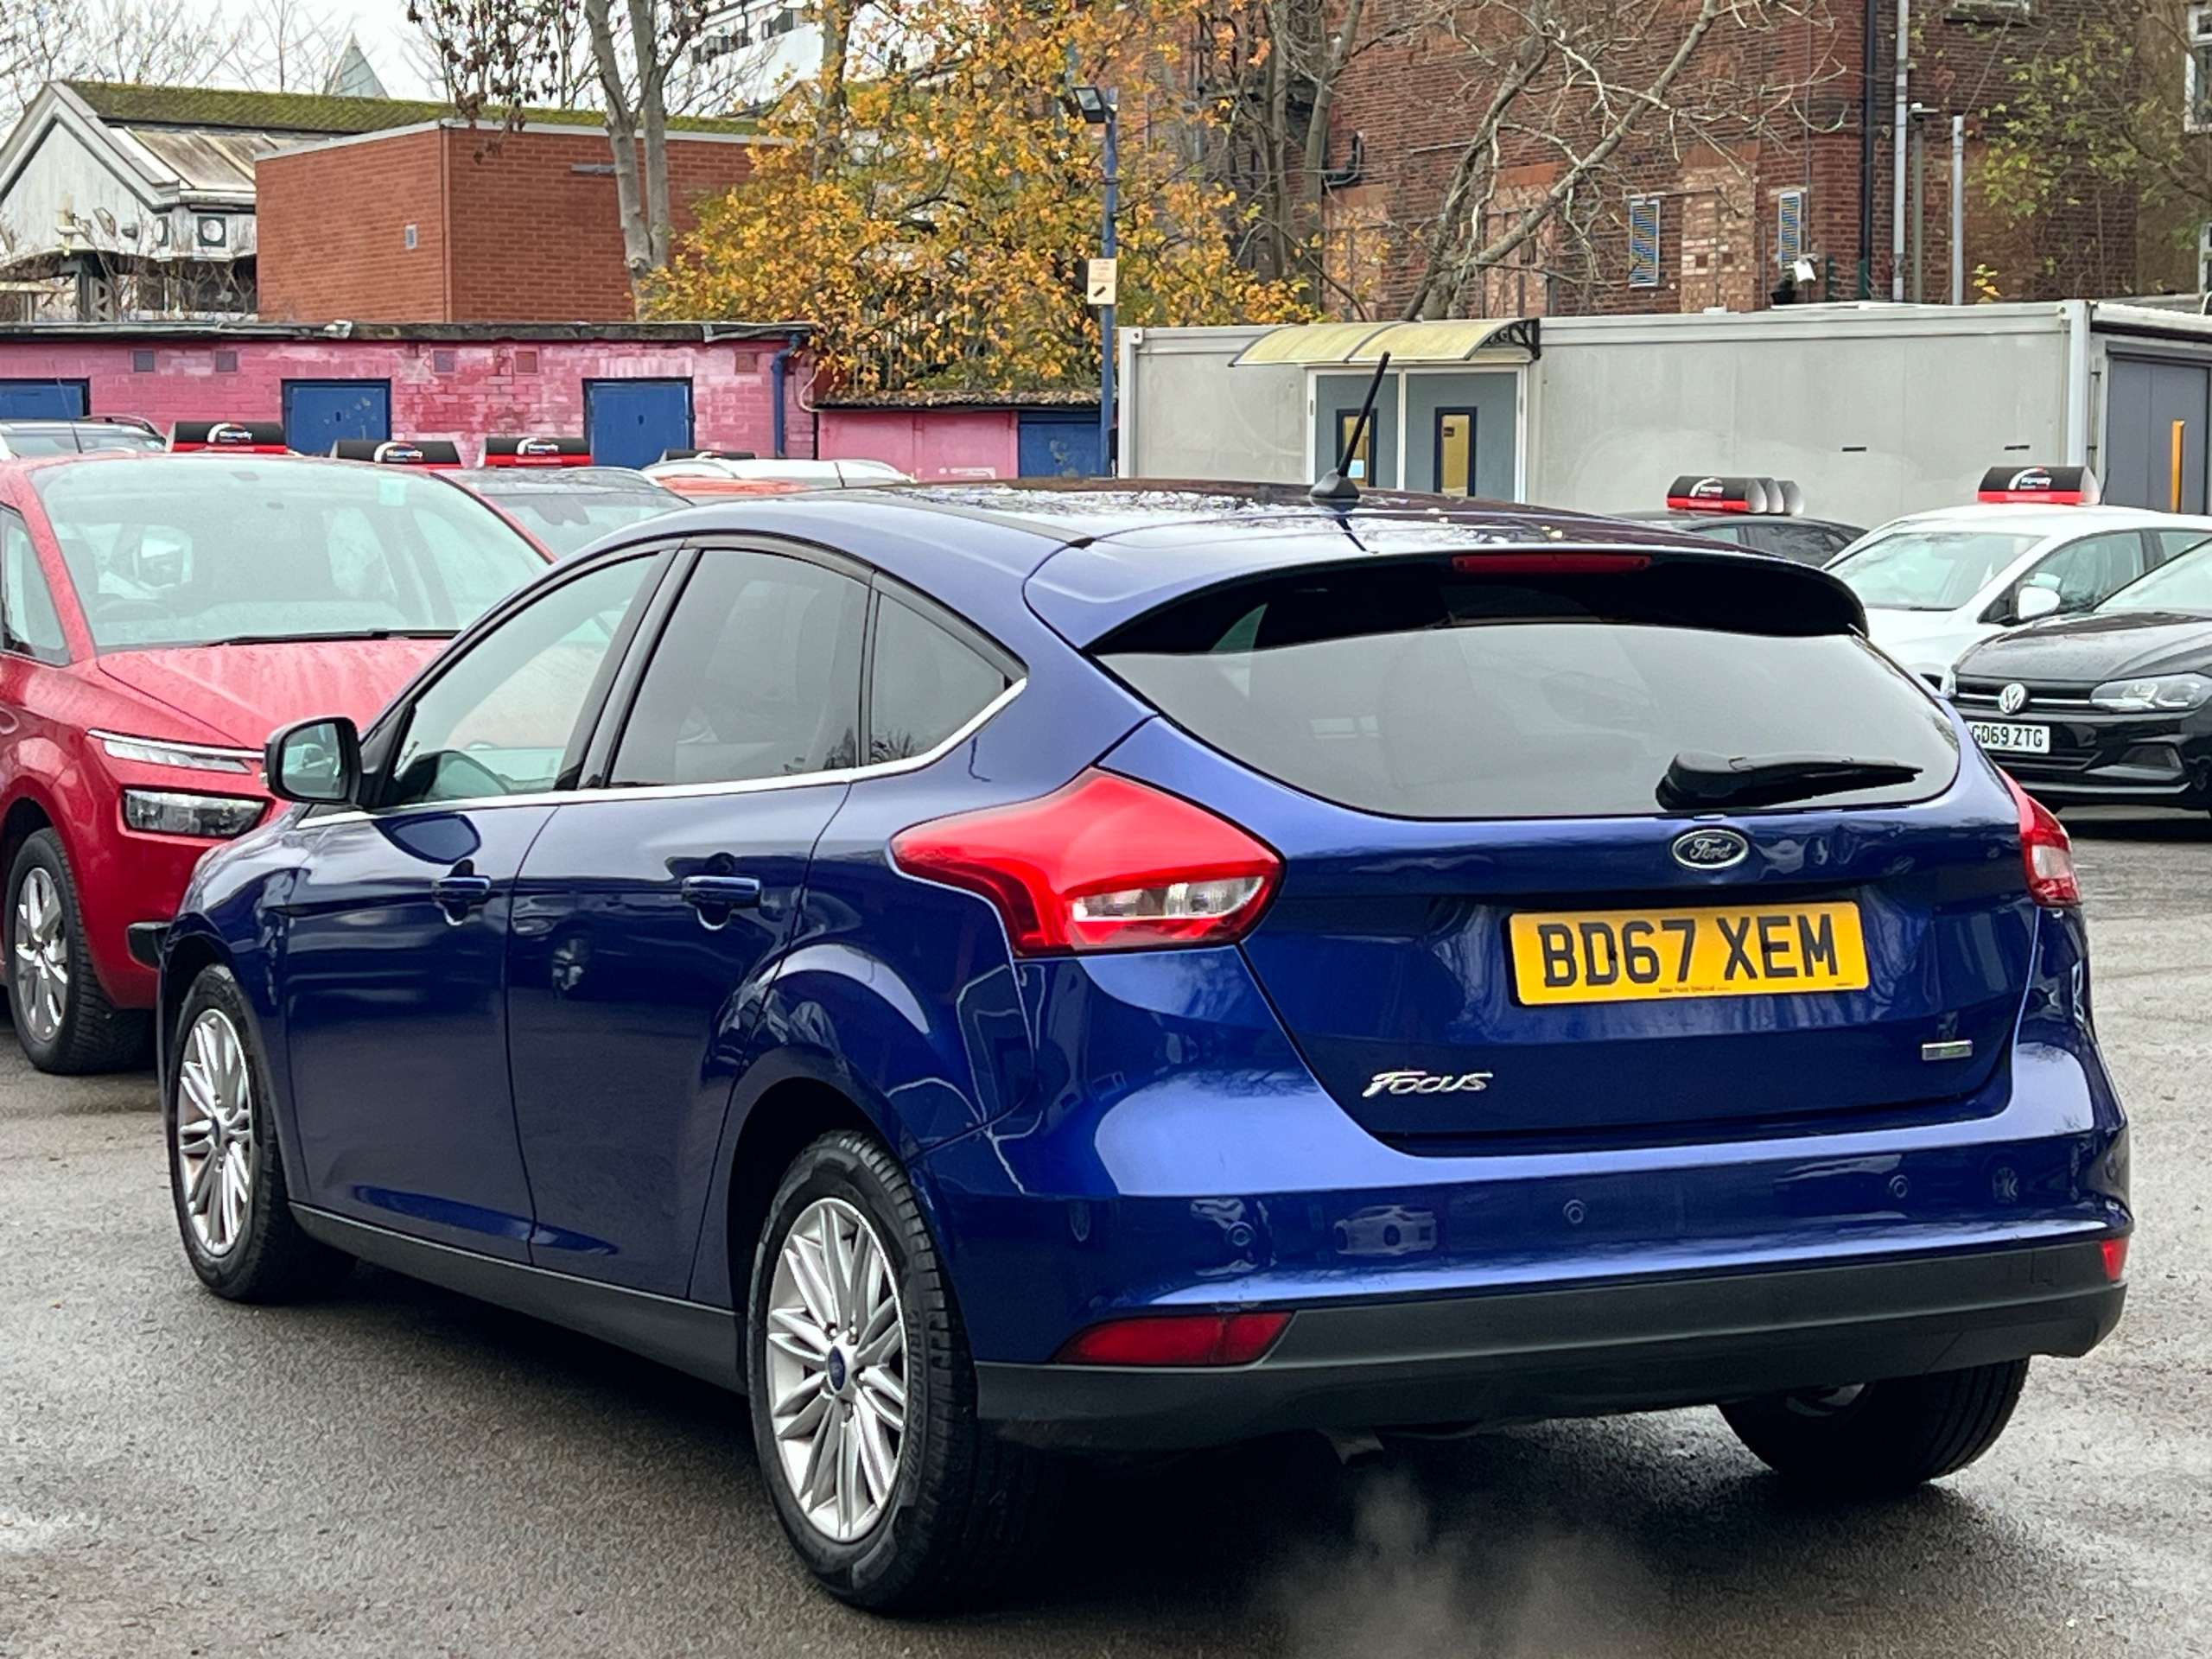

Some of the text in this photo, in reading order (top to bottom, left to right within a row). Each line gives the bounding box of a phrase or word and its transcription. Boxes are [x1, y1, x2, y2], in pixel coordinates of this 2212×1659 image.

[1971, 724, 2044, 747] GD69 ZTG
[1688, 837, 1732, 860] Ford
[1537, 913, 1839, 988] BD67 XEM
